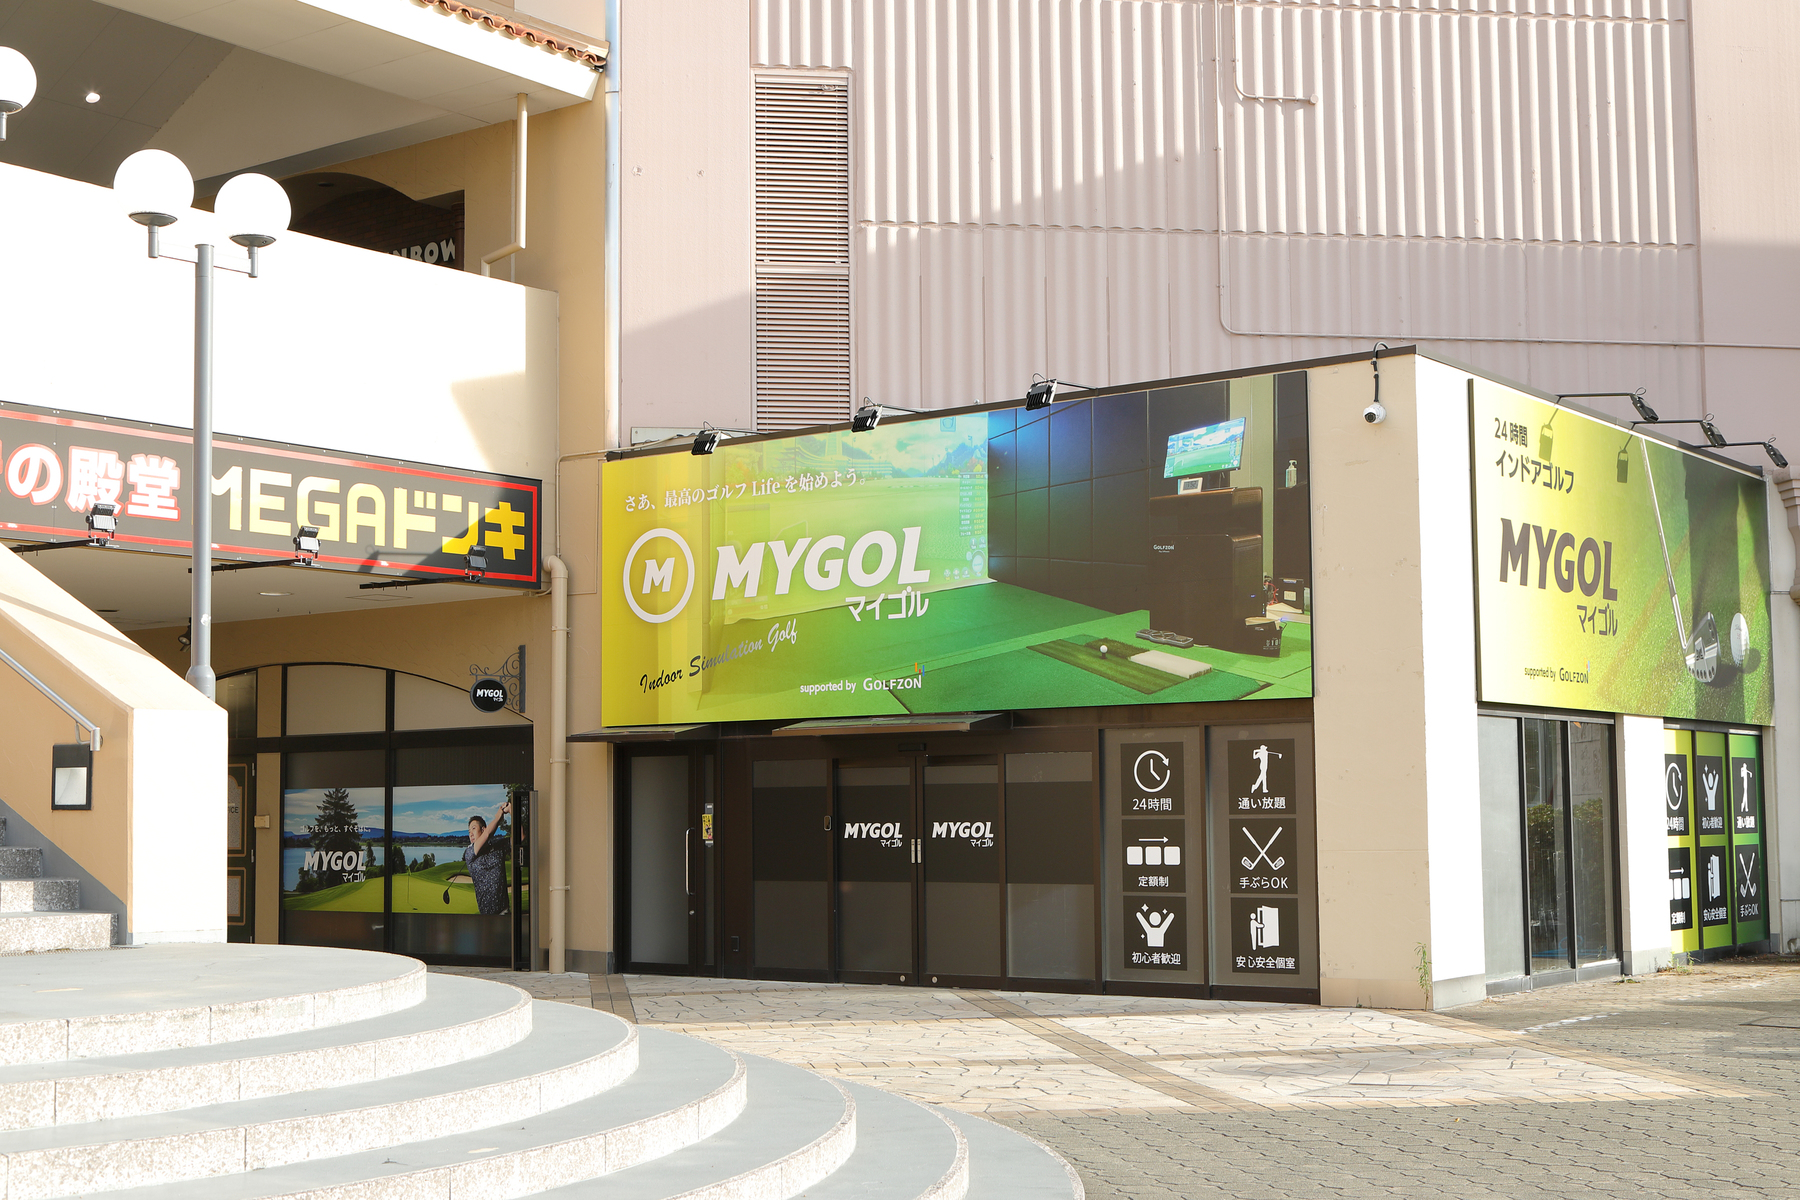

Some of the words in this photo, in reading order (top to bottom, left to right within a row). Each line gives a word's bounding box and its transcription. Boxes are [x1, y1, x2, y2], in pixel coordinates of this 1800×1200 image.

[1495, 449, 1575, 494] インドアゴルフ
[0, 443, 180, 520] の殿堂
[712, 526, 931, 600] MYGOL
[1500, 517, 1618, 601] MYGOL
[845, 586, 930, 622] マイゴル
[1576, 603, 1618, 637] マイゴル
[639, 668, 683, 693] Indoor
[689, 638, 763, 677] Simulation
[767, 618, 798, 652] Golf
[476, 689, 504, 698] MYGOL
[800, 680, 843, 695] supported
[845, 680, 857, 693] by
[1132, 798, 1172, 811] 24時間
[1238, 797, 1286, 810] 通い放題
[844, 822, 903, 838] MYGOL
[931, 821, 994, 838] MYGOL
[880, 838, 902, 847] マイゴル
[970, 838, 993, 847] マイゴル
[303, 851, 366, 871] MYGOL
[342, 871, 366, 882] マイゴル
[1138, 876, 1169, 887] 定額制
[1239, 877, 1289, 889] 手ぶらOK
[1131, 952, 1182, 965] 初心者歓迎
[1235, 956, 1296, 970] 安心安全個室
